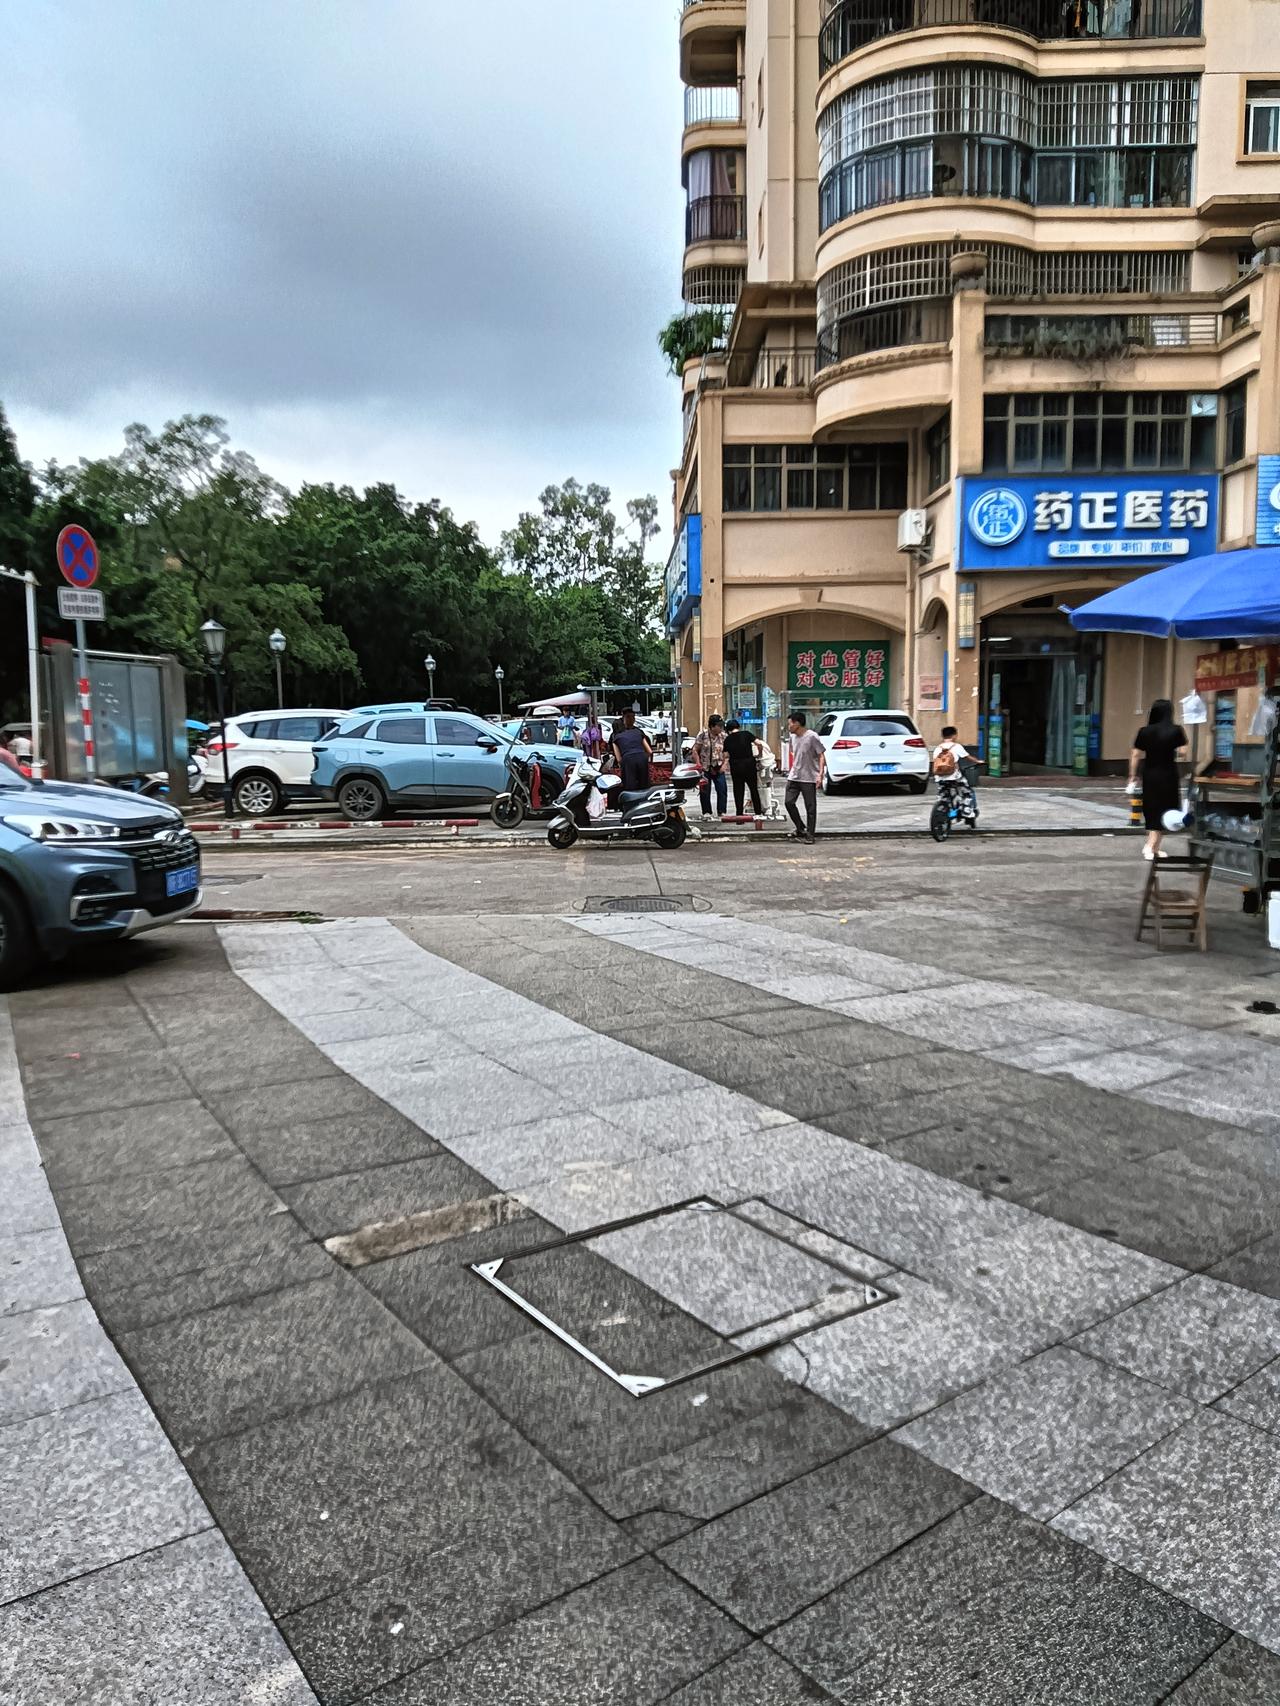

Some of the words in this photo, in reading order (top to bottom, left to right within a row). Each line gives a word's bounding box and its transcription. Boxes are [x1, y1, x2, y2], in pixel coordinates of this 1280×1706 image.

[1033, 489, 1209, 531] 药正医药
[796, 649, 885, 669] 对血管好
[796, 669, 885, 688] 对心脏好
